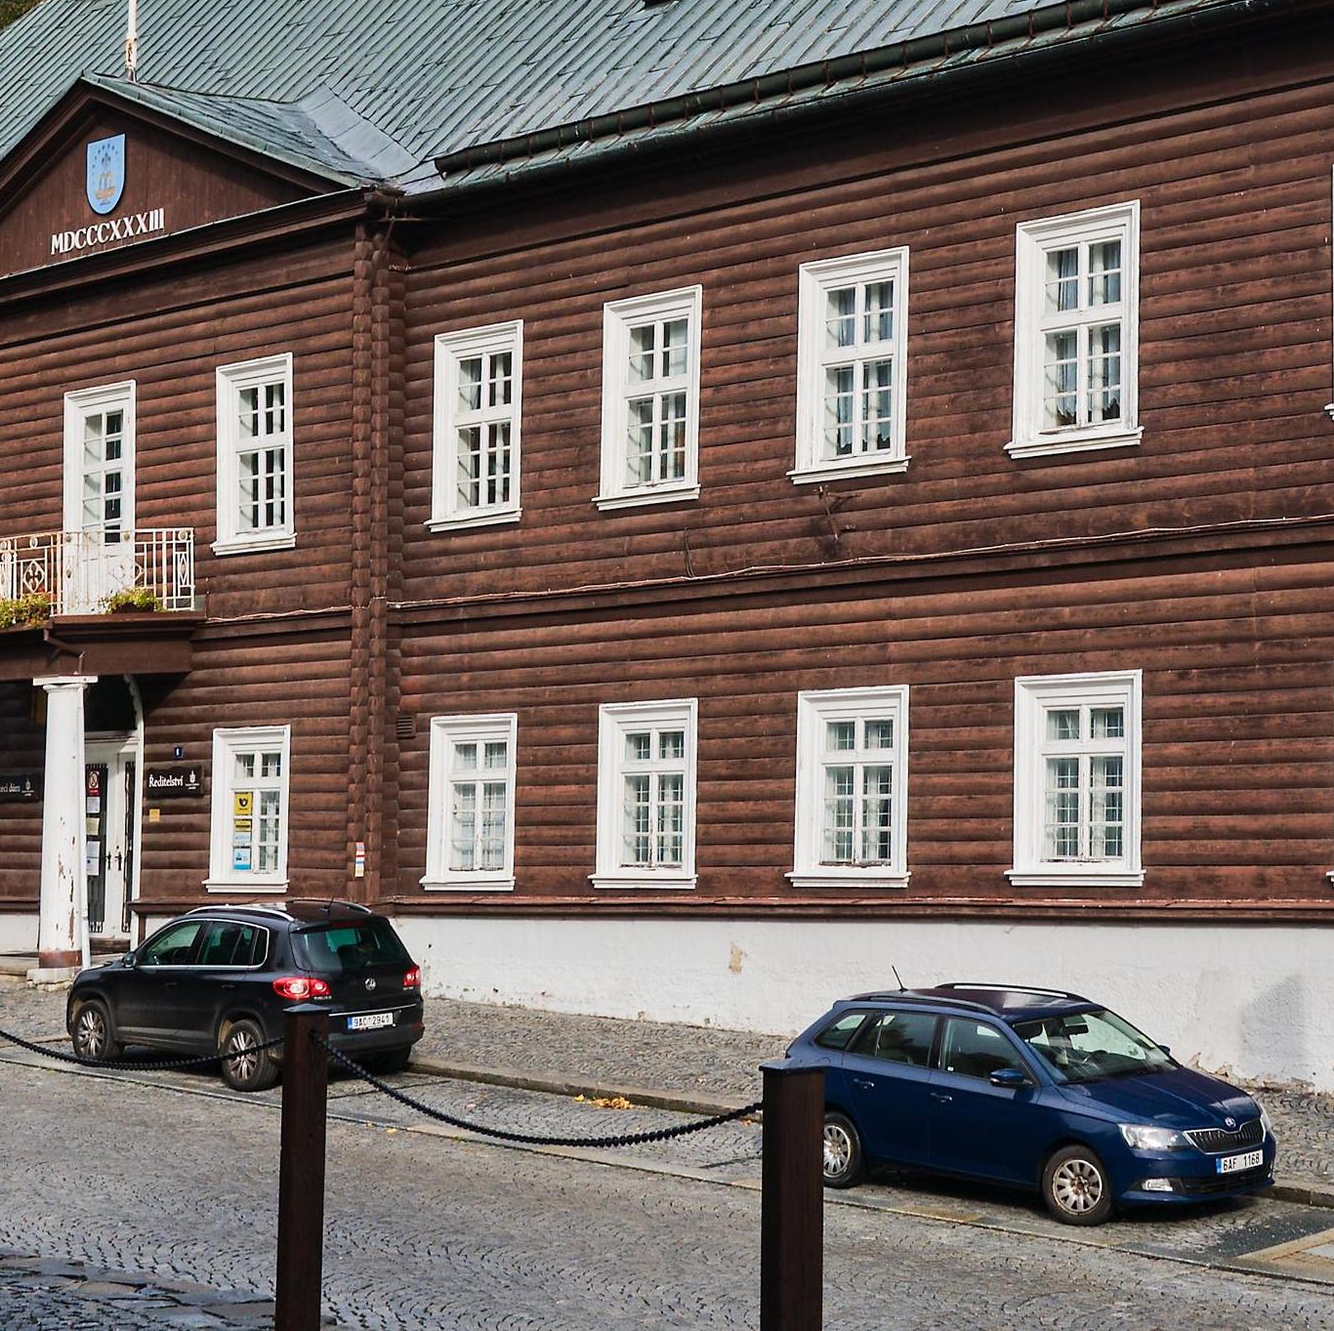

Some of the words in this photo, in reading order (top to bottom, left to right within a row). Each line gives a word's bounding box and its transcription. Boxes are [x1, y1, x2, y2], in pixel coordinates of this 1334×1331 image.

[51, 208, 165, 255] MDCCCXXXIII
[149, 774, 184, 788] Ředitelství
[1223, 1158, 1237, 1171] 6AF
